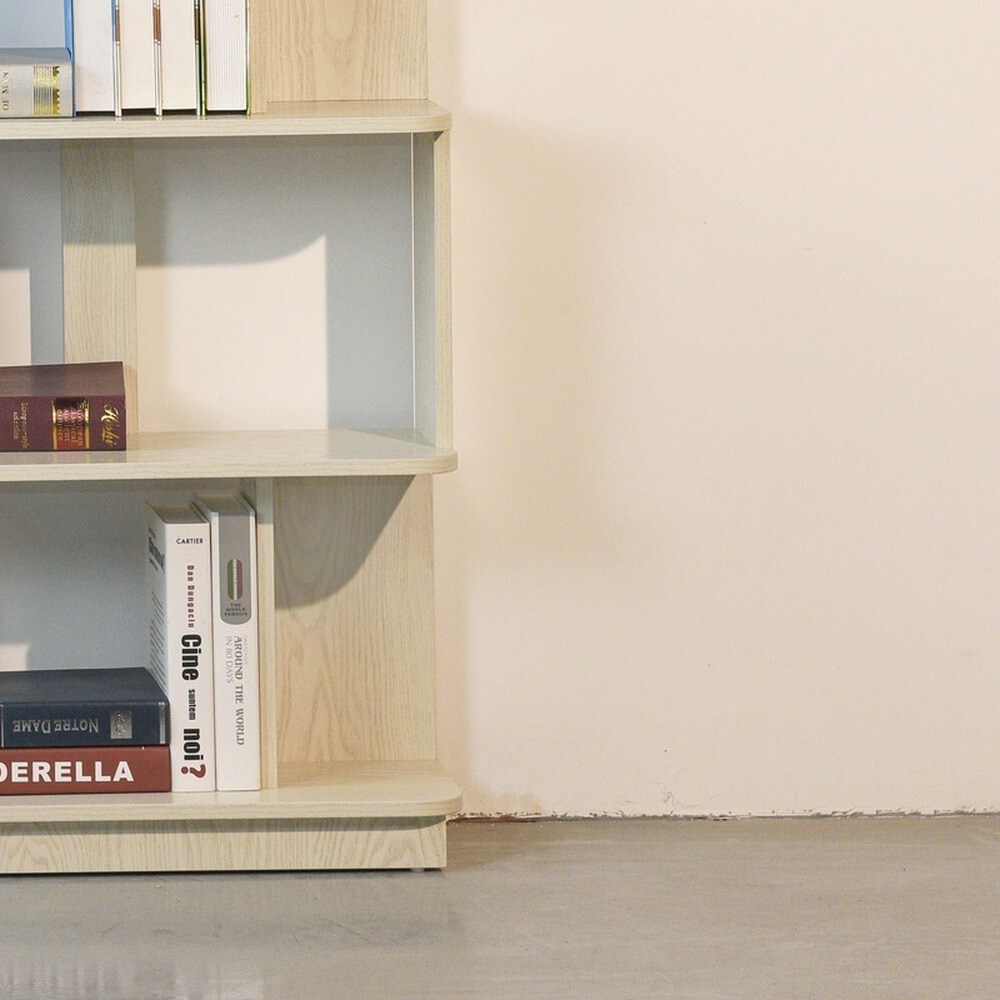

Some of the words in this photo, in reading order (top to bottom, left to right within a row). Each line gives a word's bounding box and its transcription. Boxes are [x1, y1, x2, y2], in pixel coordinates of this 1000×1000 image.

[226, 635, 234, 646] IN
[181, 634, 202, 681] Cine
[226, 647, 234, 659] 80
[234, 636, 244, 680] AROUND
[226, 660, 235, 684] DAYS
[188, 689, 196, 721] suntem
[235, 684, 244, 704] THE
[13, 719, 51, 734] DAME
[53, 718, 99, 733] NOTRE
[235, 708, 245, 746] WORLD
